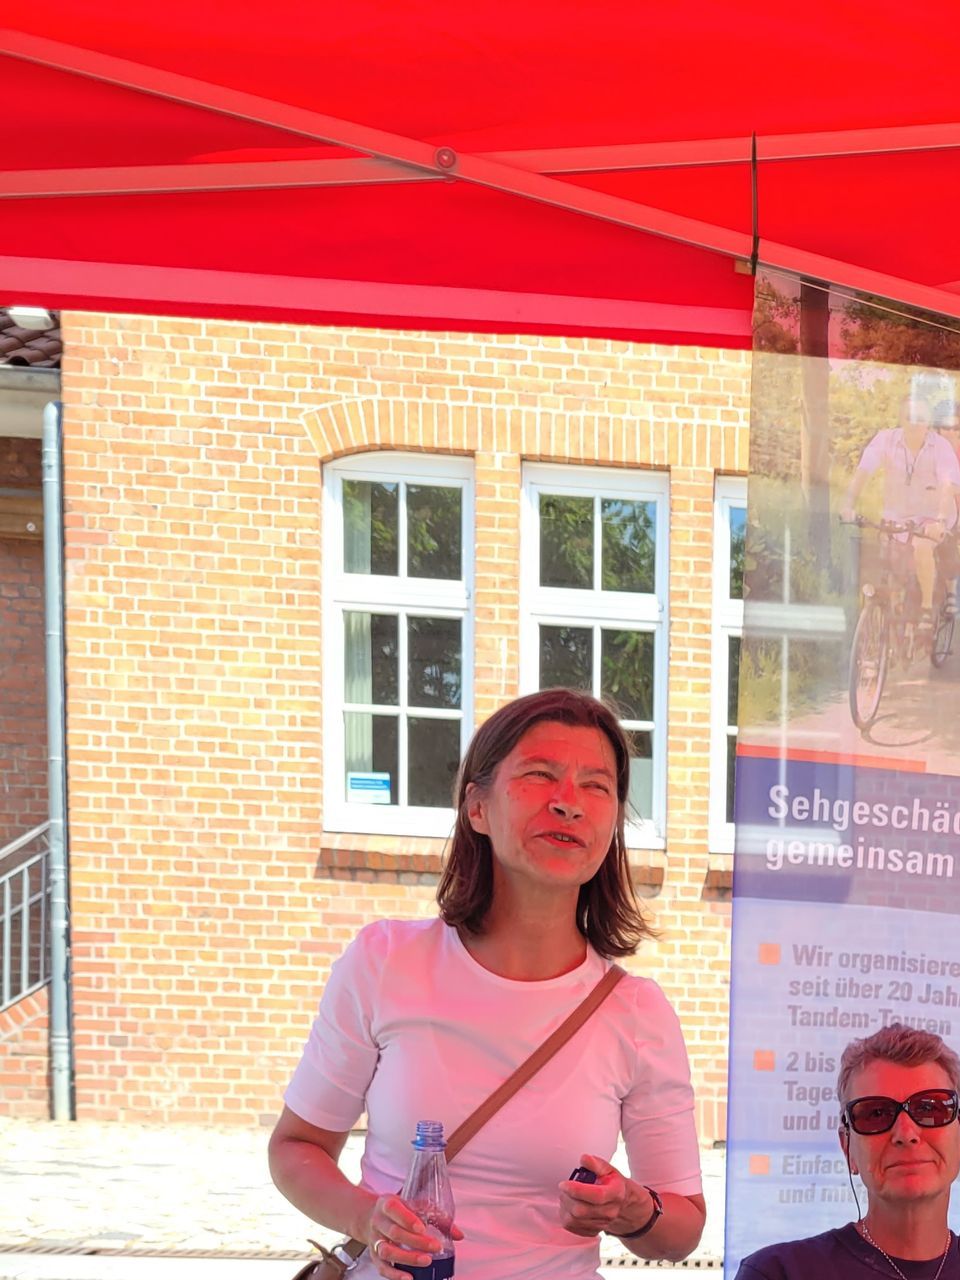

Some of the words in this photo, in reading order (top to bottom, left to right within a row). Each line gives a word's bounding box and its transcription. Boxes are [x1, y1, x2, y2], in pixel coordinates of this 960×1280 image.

[766, 836, 955, 877] gemeinsam
[791, 943, 833, 968] Wir
[788, 977, 831, 998] seit
[835, 975, 883, 1001] über
[887, 983, 913, 1003] 20
[785, 1051, 799, 1072] 2
[804, 1052, 836, 1073] bis
[783, 1111, 820, 1132] und
[778, 1182, 816, 1204] und
